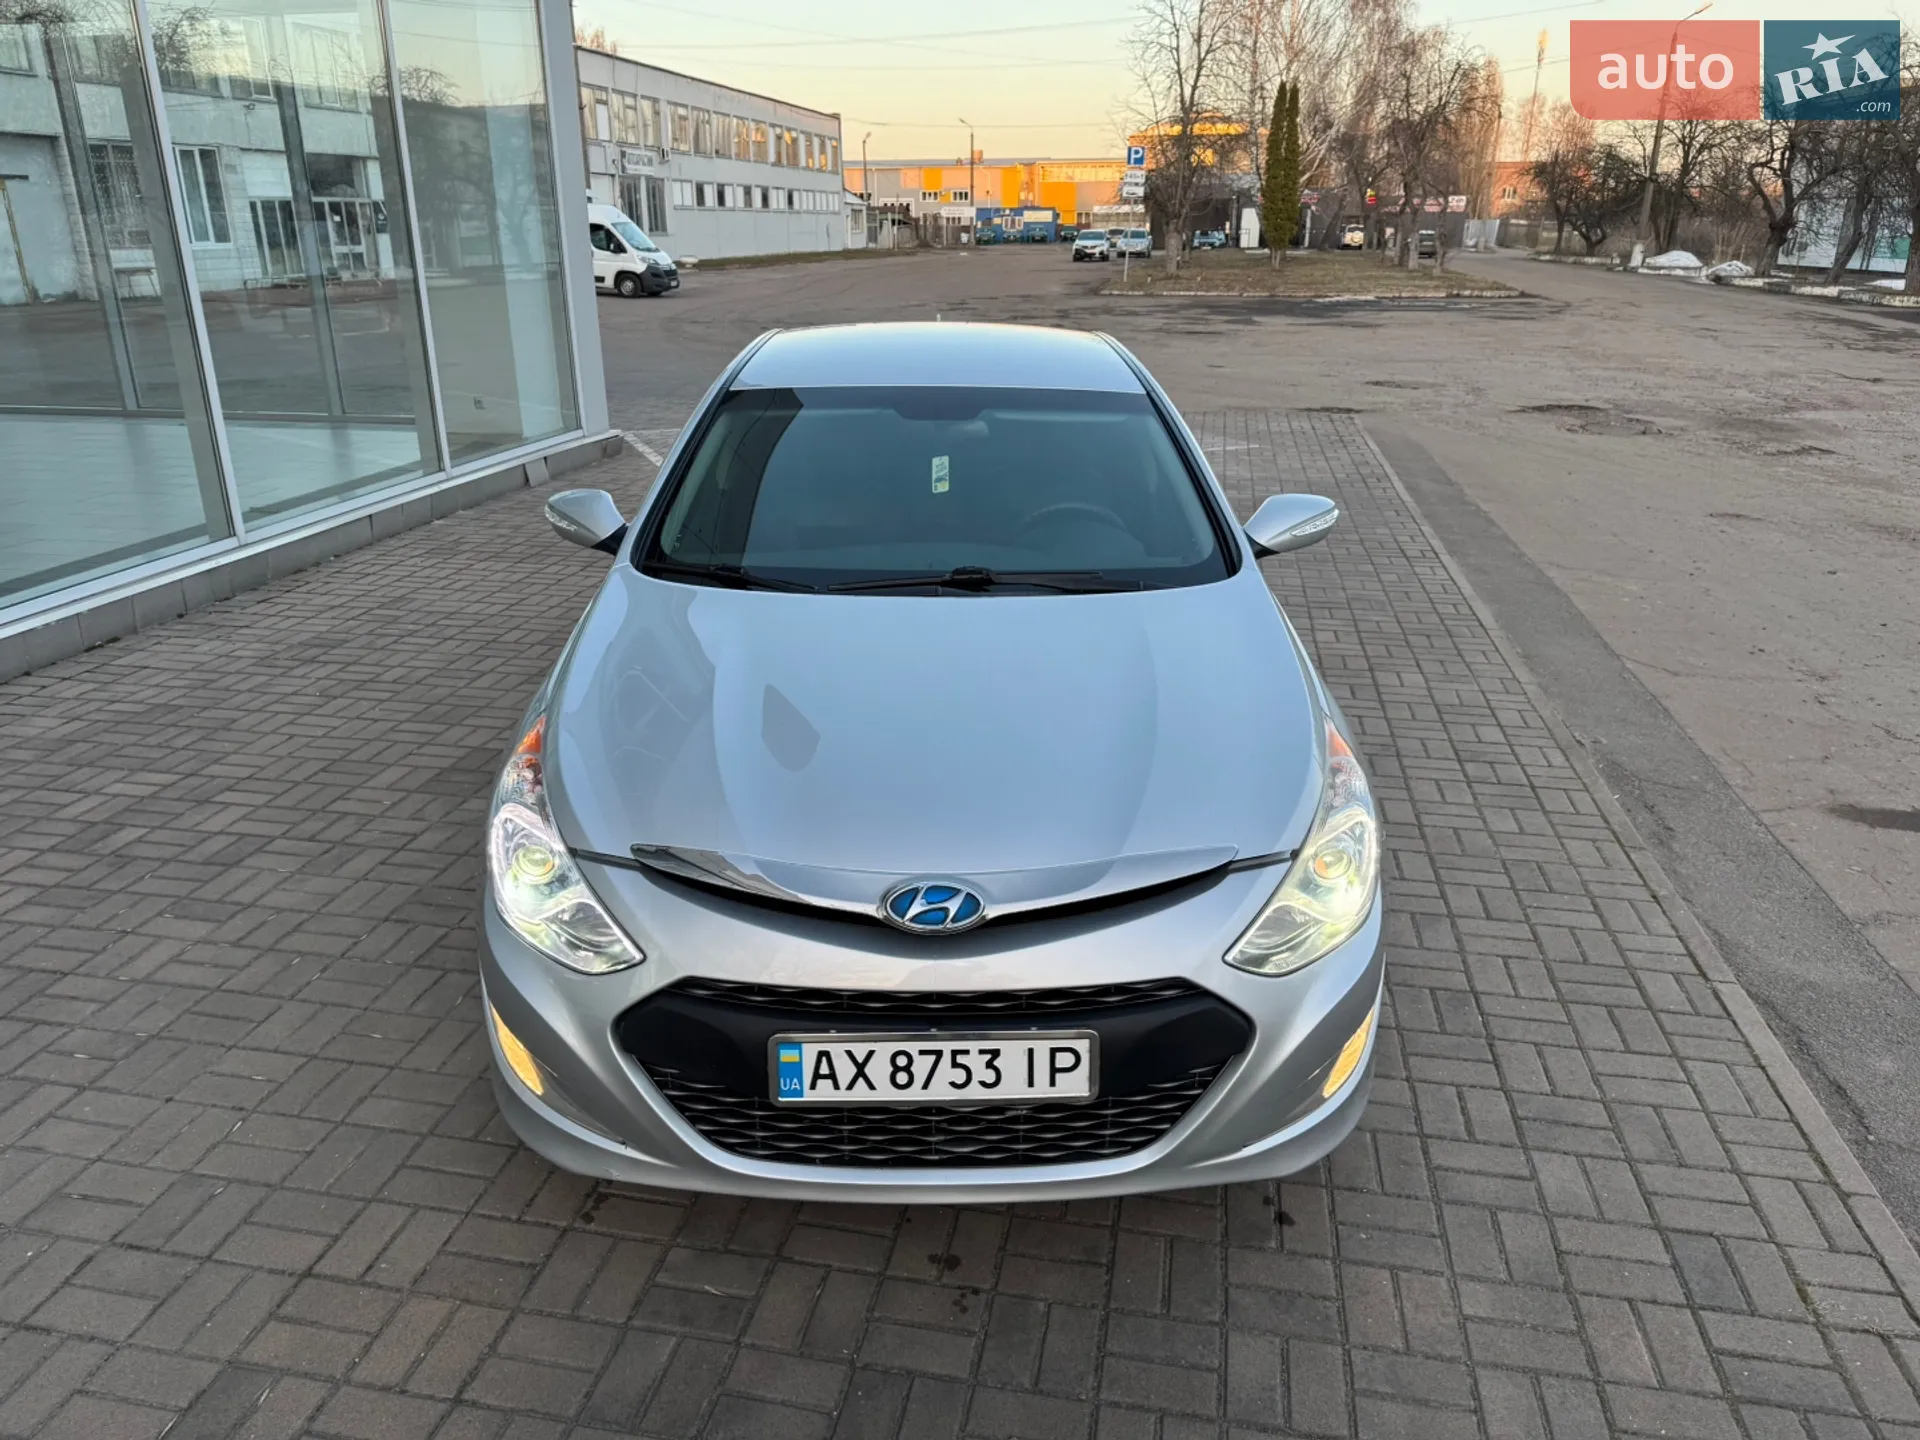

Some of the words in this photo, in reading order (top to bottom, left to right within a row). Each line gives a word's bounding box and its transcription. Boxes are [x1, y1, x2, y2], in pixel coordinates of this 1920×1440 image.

[1130, 146, 1143, 165] P
[809, 1049, 877, 1091] AX
[889, 1048, 1002, 1091] 8753
[1027, 1047, 1082, 1088] IP
[780, 1077, 801, 1091] UA
